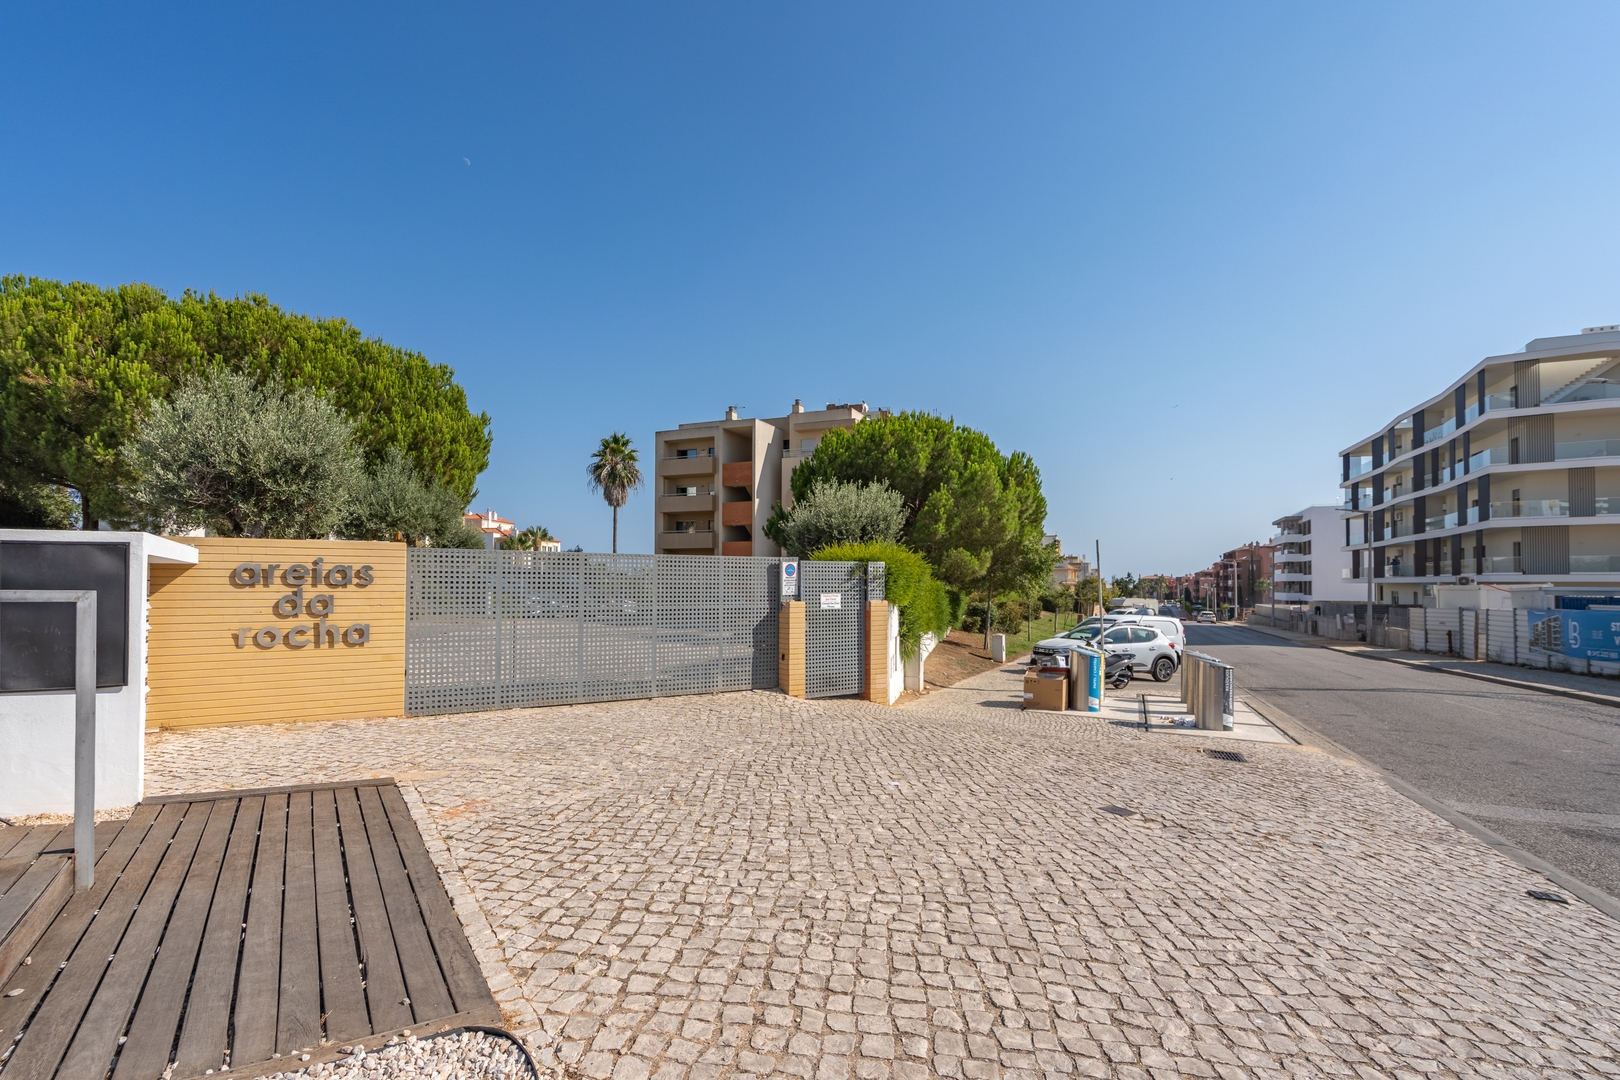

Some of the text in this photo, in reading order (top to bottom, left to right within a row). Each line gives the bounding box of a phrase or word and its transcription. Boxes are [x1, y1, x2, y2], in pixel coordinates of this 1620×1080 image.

[235, 557, 374, 585] areias
[278, 587, 335, 615] da
[237, 617, 370, 648] rocha
